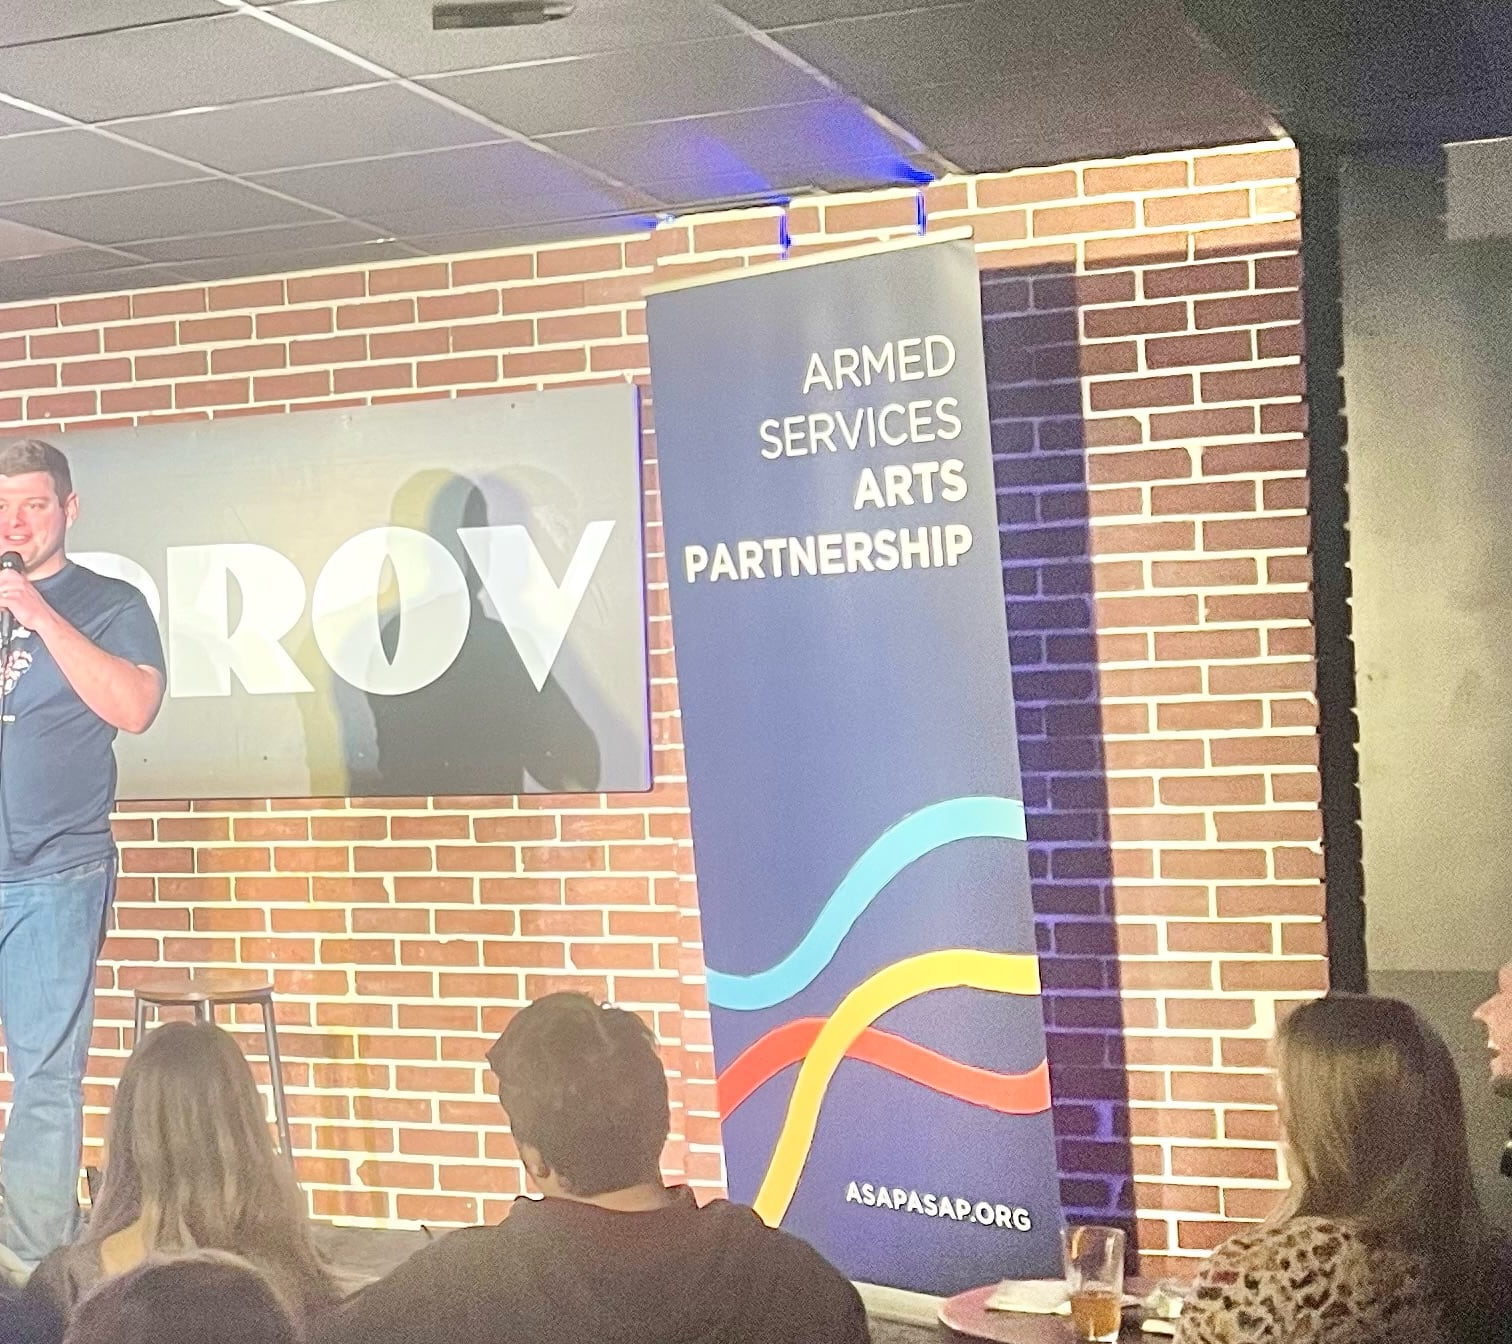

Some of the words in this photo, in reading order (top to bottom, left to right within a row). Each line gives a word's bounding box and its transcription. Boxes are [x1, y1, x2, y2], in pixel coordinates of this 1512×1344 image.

[802, 334, 956, 394] ARMED
[759, 396, 962, 460] SERVICES
[853, 458, 969, 511] ARTS
[684, 523, 973, 584] PARTNERSHIP
[845, 1181, 1032, 1232] ASAPASAP.ORG
